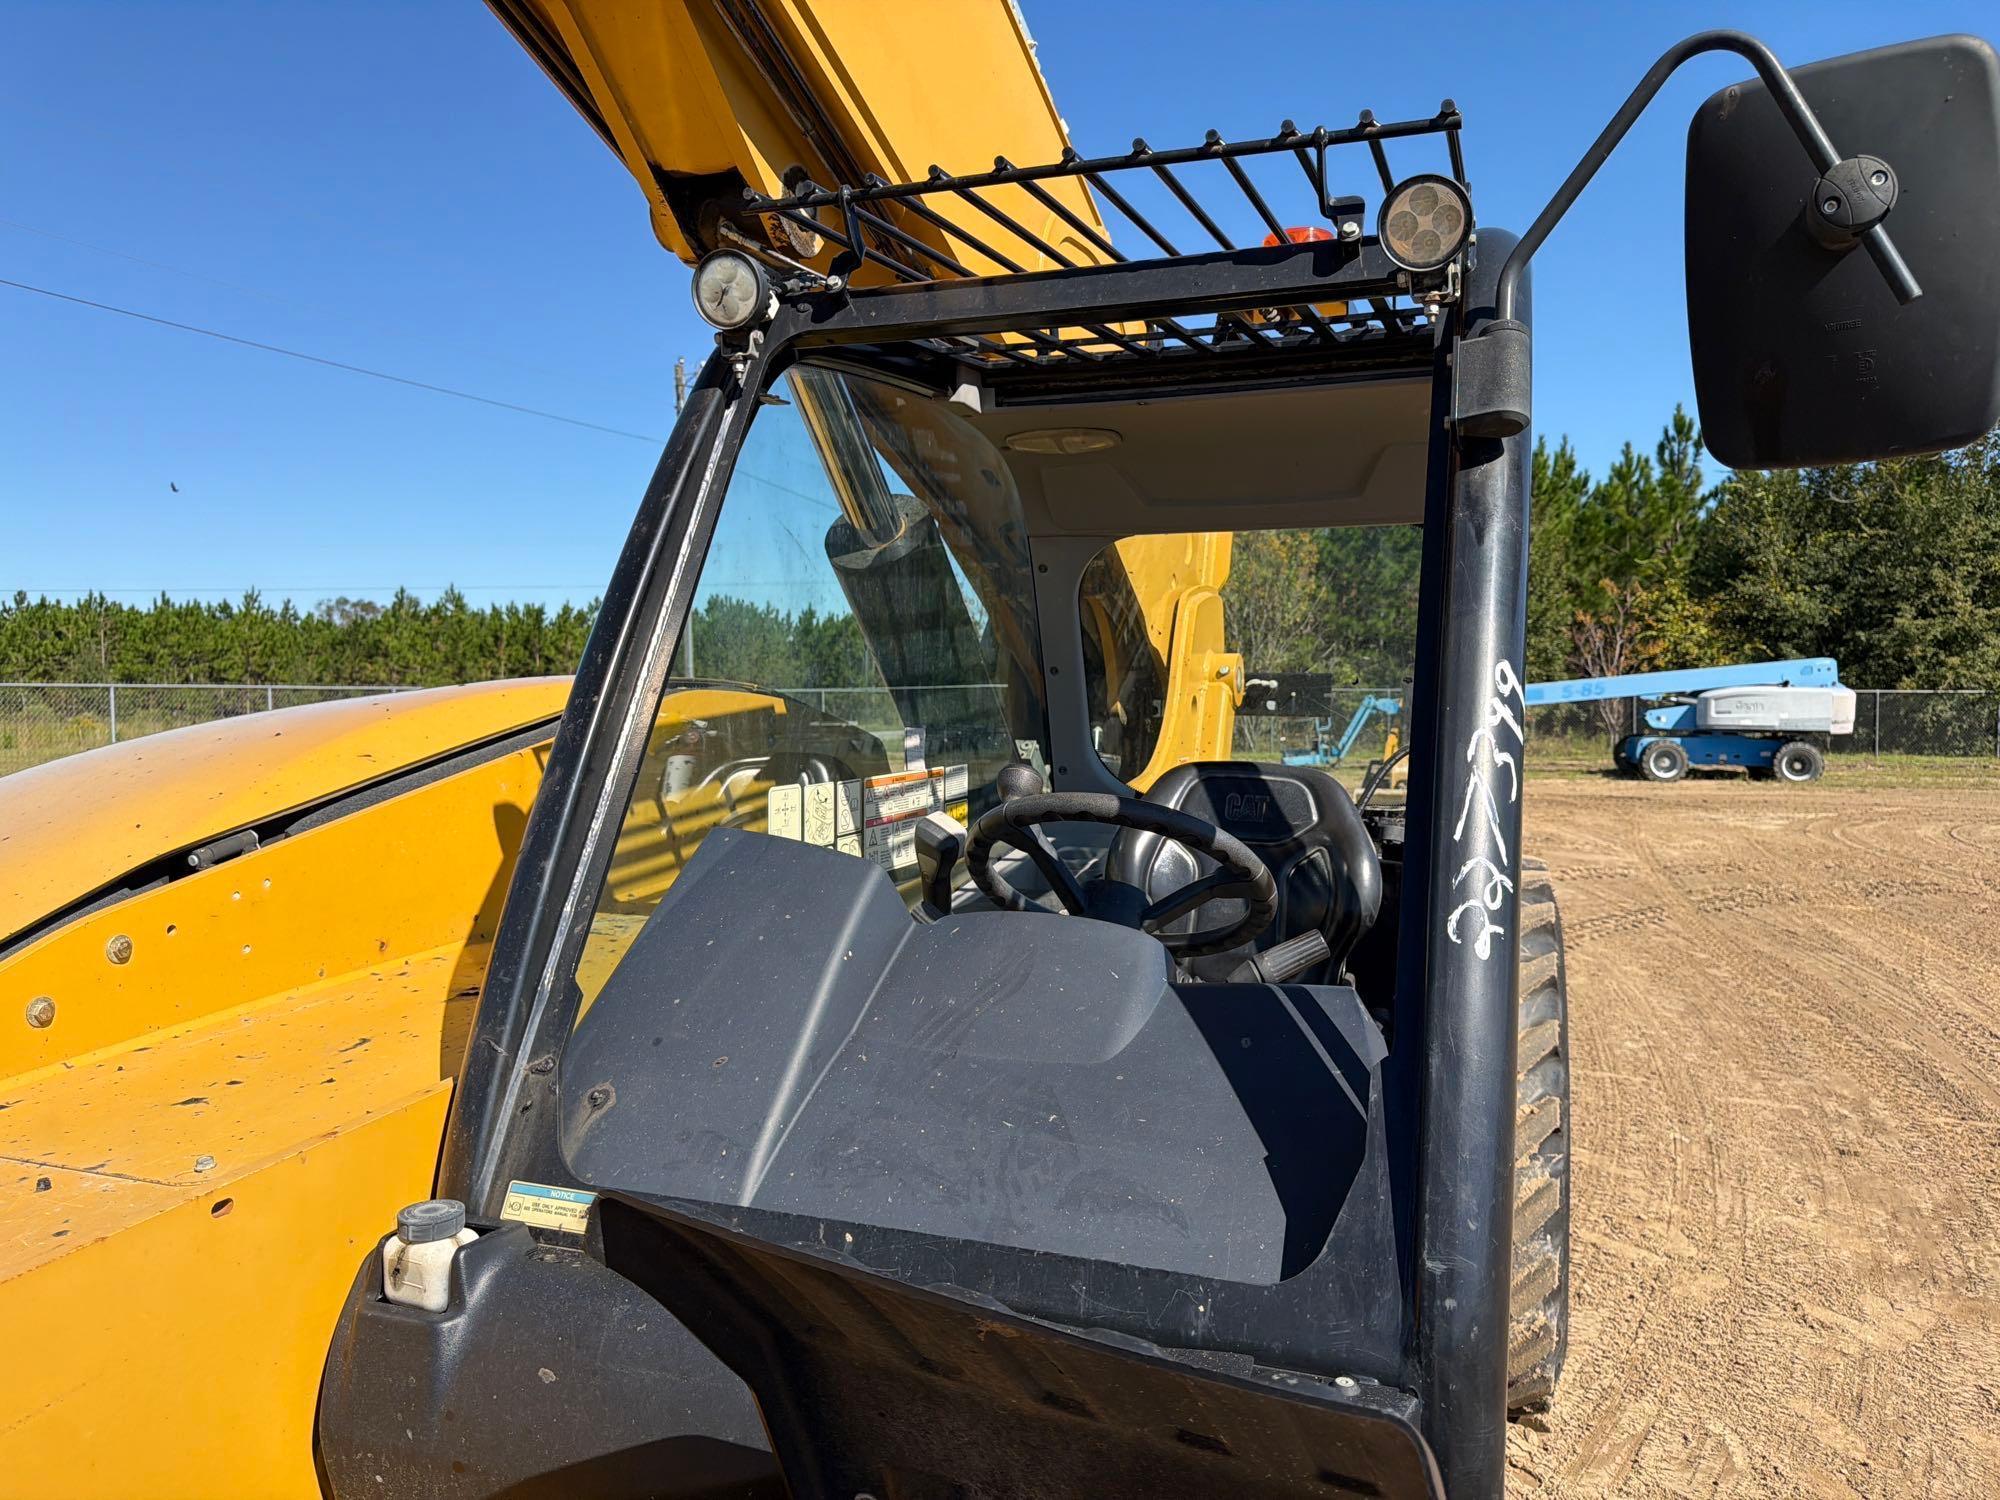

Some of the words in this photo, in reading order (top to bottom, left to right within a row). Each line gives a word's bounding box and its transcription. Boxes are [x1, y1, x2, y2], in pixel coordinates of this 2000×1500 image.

[1562, 682, 1605, 699] S-85
[1224, 792, 1271, 822] CAT
[550, 1190, 576, 1200] NOTICE
